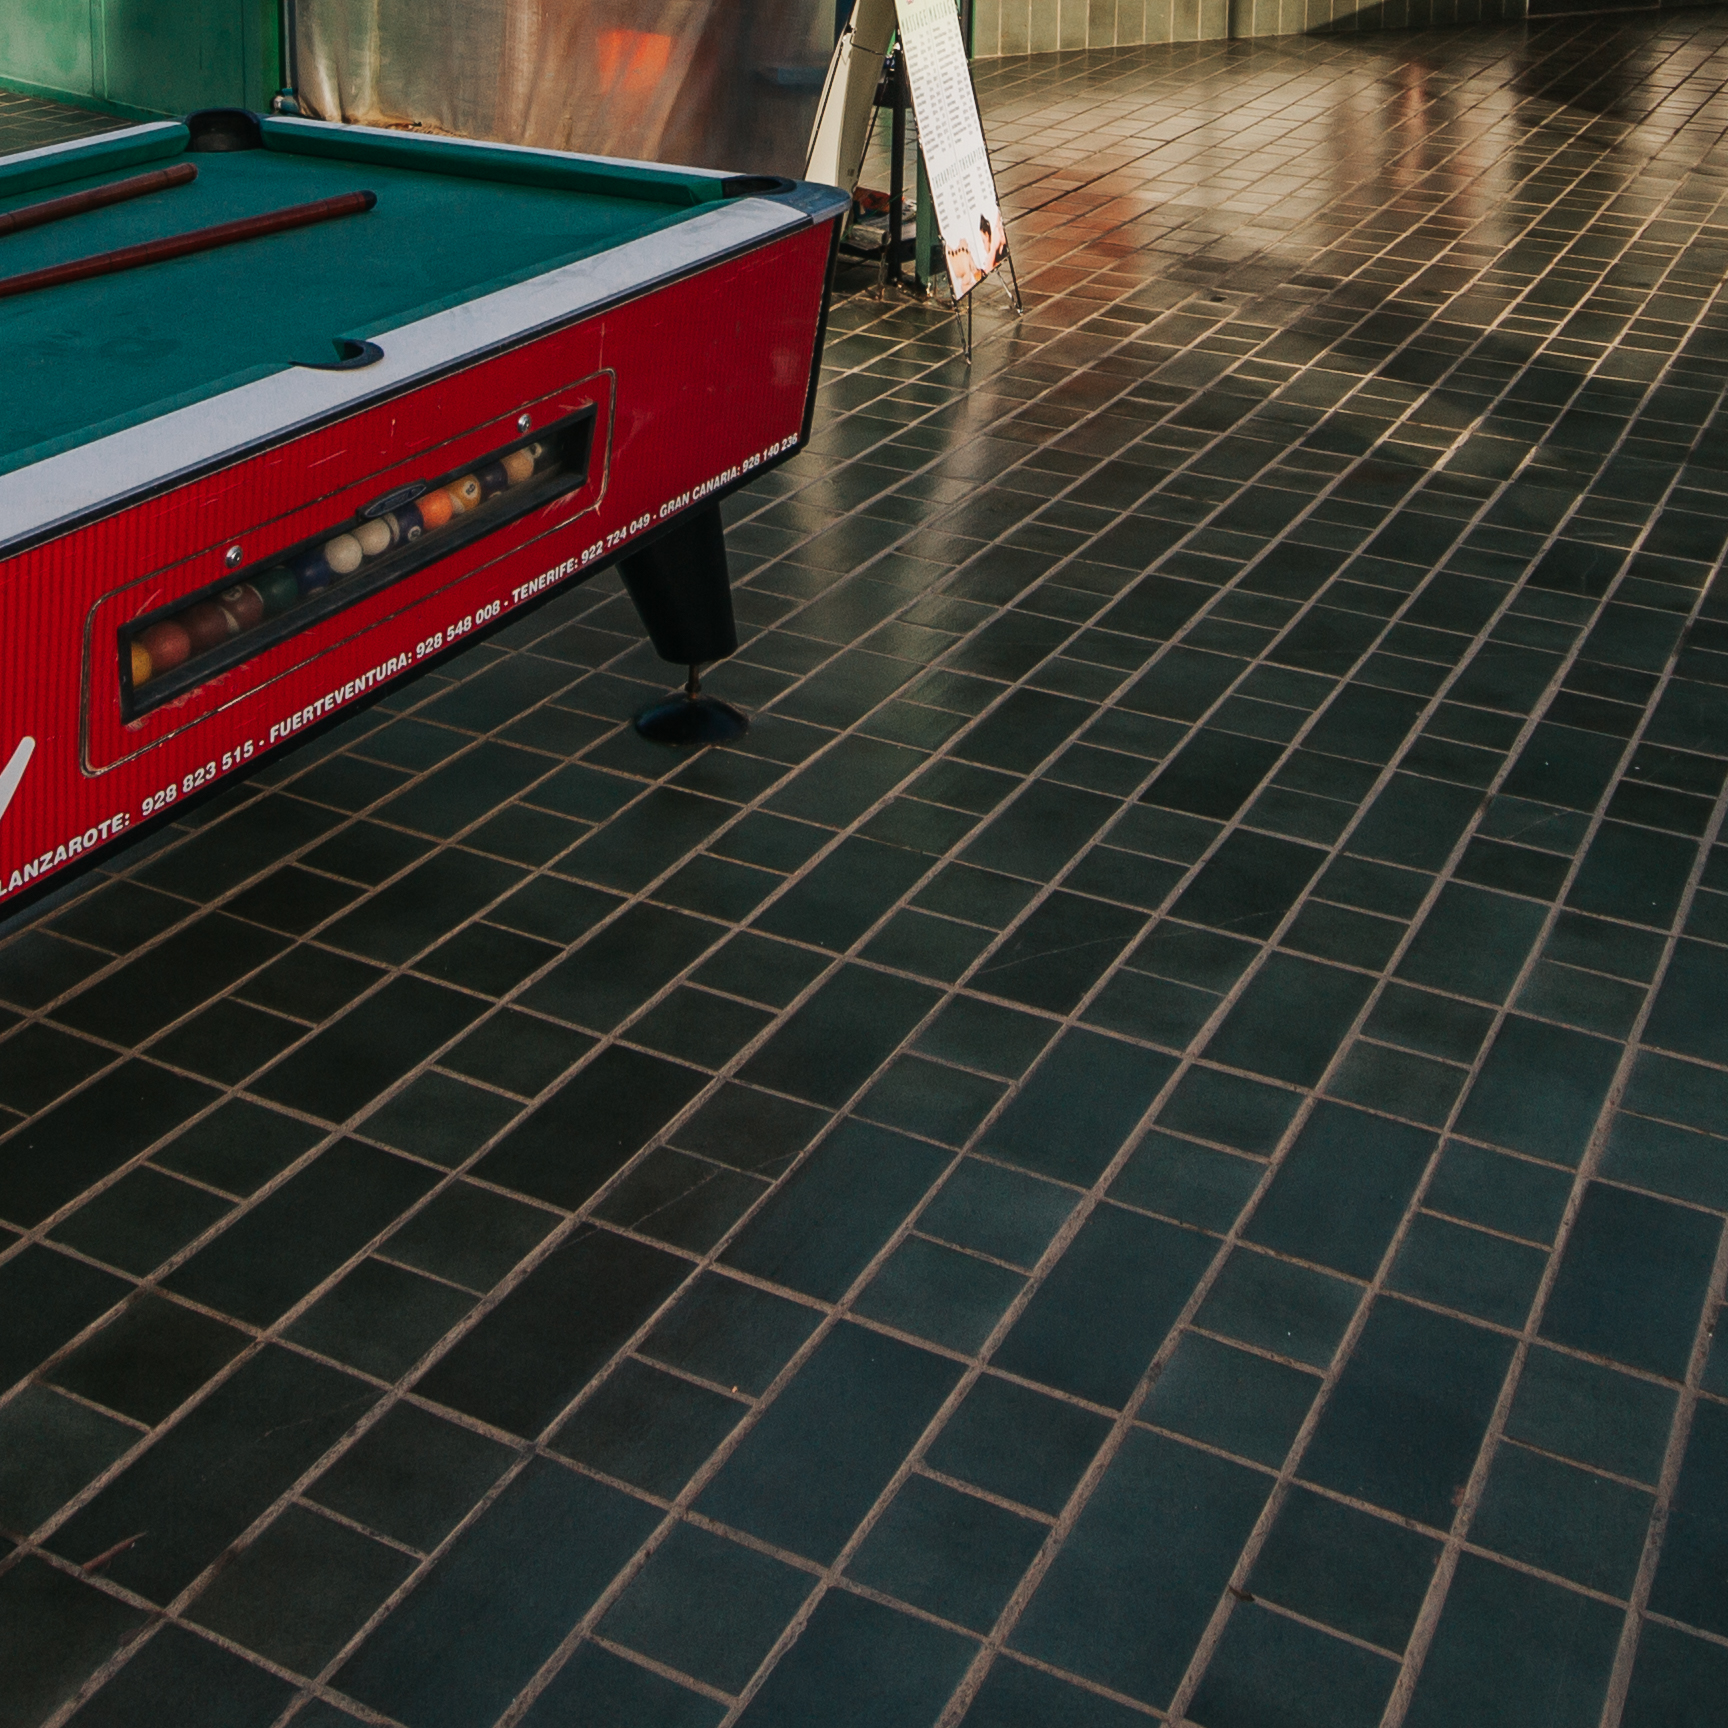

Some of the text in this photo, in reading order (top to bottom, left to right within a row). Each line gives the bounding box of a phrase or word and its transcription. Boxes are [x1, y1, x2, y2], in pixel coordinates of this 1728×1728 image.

[141, 783, 177, 816] 928
[182, 761, 217, 793] 823
[221, 740, 254, 771] 515
[269, 651, 413, 743] FUERTEVENTURA:
[415, 632, 443, 659] 928
[446, 616, 472, 642] 548
[475, 599, 500, 625] 008
[511, 557, 578, 603] TENERIFE:
[581, 540, 604, 564] 922
[606, 525, 627, 548] 724
[629, 513, 651, 534] 049
[659, 491, 690, 518] GRAN
[692, 466, 740, 500] CANARIA:
[742, 453, 761, 473] 928
[763, 442, 780, 461] 140
[781, 432, 798, 451] 236
